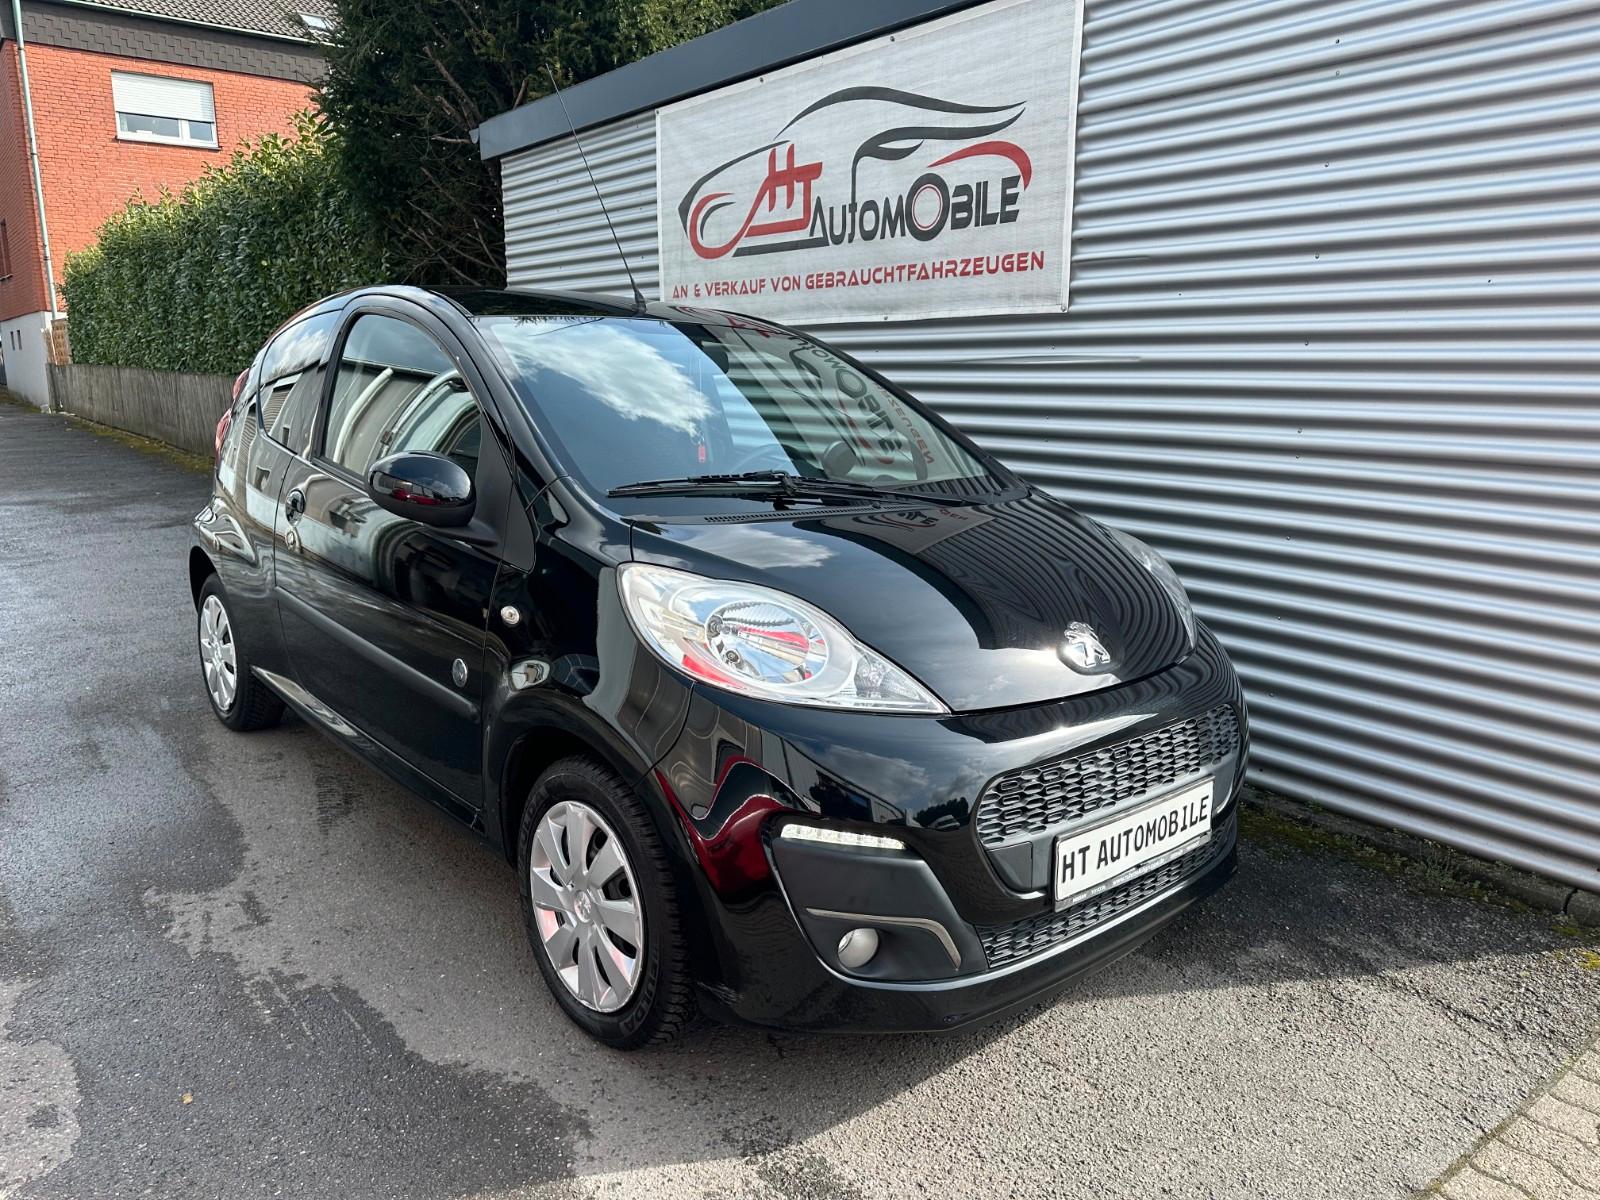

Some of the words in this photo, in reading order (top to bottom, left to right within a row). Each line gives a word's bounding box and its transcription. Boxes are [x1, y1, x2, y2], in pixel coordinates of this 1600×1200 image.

[809, 172, 1021, 246] AUTOMOBILE
[673, 285, 688, 298] AN
[694, 283, 701, 297] &
[705, 278, 766, 297] VERKAUF
[771, 275, 801, 291] VON
[806, 251, 1044, 289] GEBRAUCHTFAHRZEUGEN
[1061, 845, 1091, 883] HT
[1096, 794, 1210, 870] AUTOMOBILE
